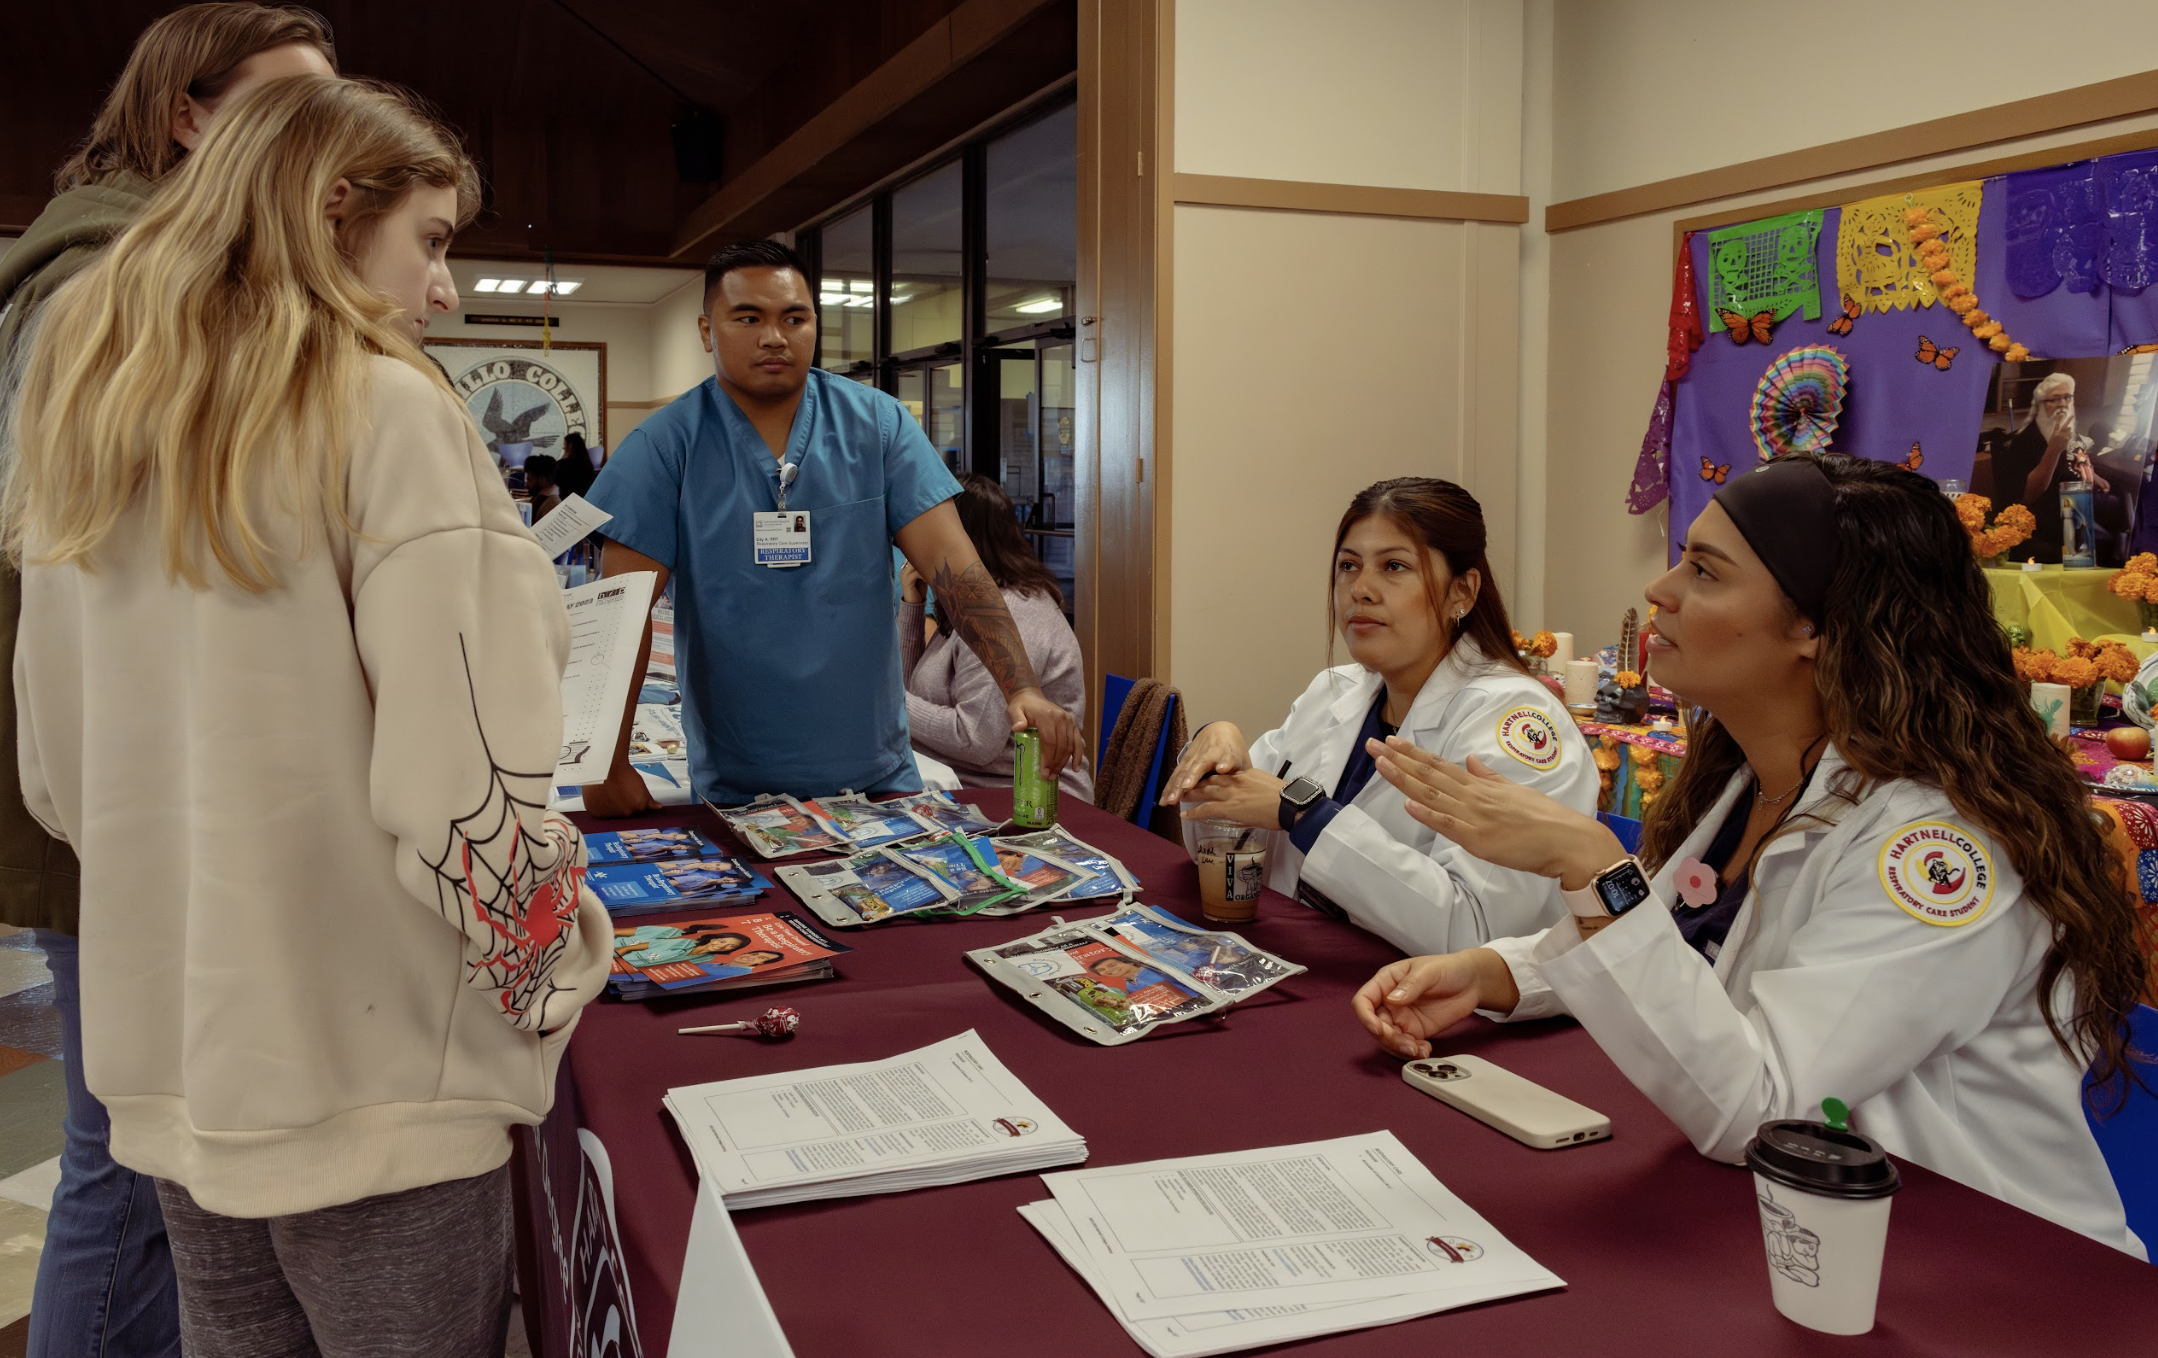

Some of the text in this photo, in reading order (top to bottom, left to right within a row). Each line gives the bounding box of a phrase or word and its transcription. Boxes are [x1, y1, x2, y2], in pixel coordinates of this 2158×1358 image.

[1226, 854, 1234, 899] VIVA
[1888, 866, 1980, 917] RESPIRATORY CARE STUDENT
[752, 926, 784, 949] Therapist
[774, 934, 813, 956] Respiratory
[1073, 946, 1113, 960] iratory
[542, 1138, 568, 1304] Degree
